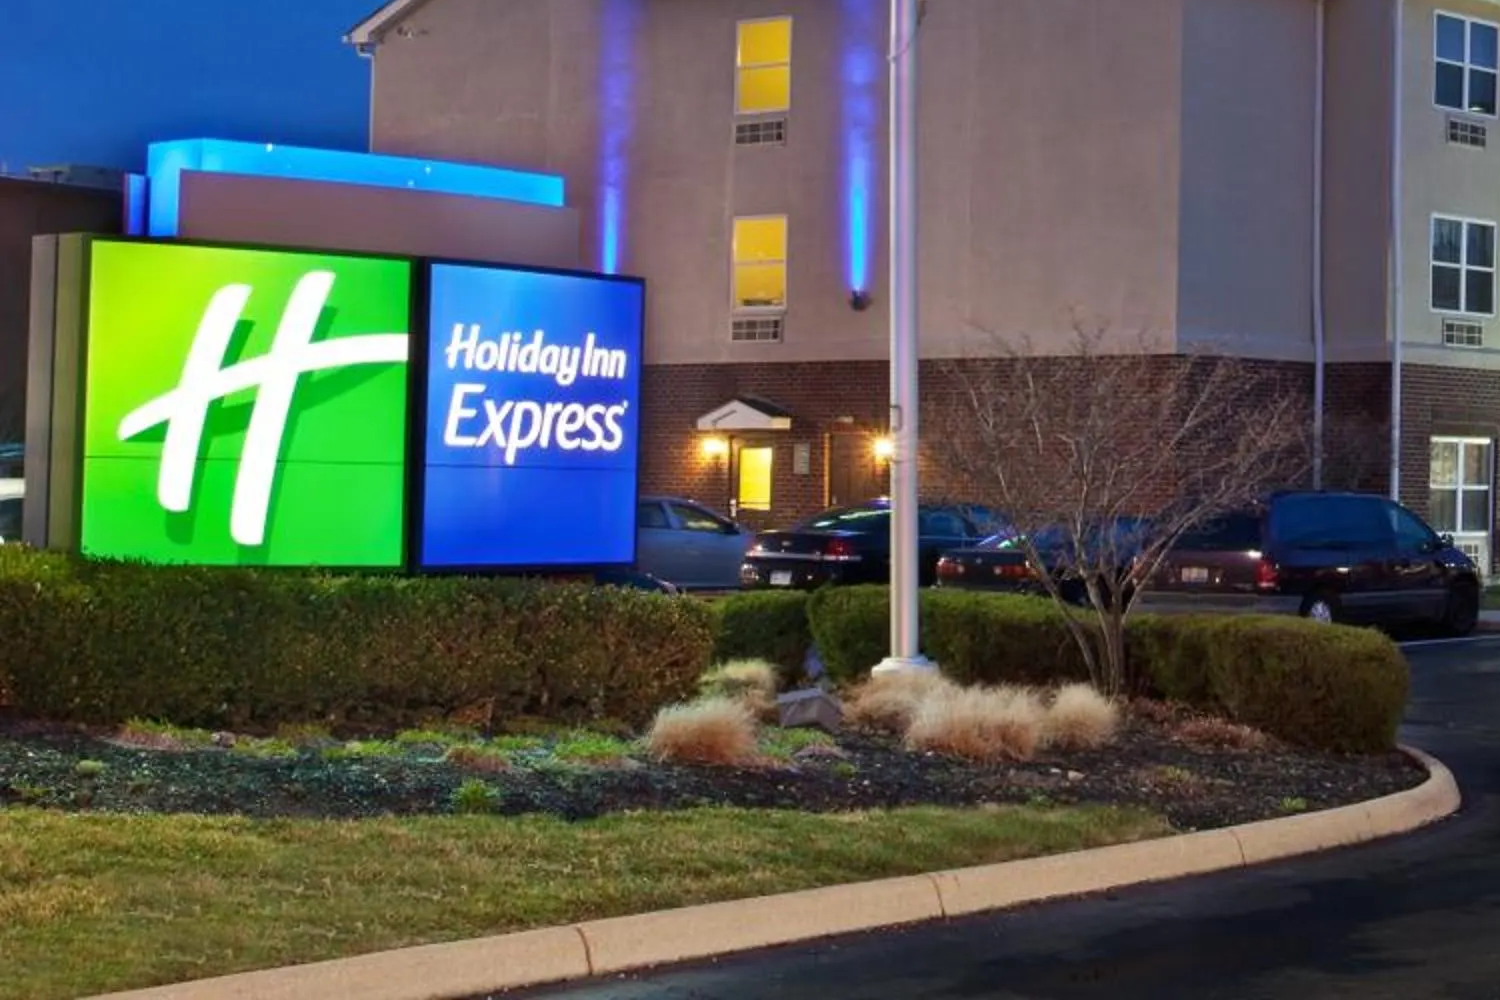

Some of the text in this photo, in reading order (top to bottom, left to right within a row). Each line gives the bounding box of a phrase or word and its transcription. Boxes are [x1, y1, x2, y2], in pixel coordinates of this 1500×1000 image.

[445, 323, 627, 386] Holiday Inn
[116, 270, 409, 546] H
[444, 382, 627, 465] Express
